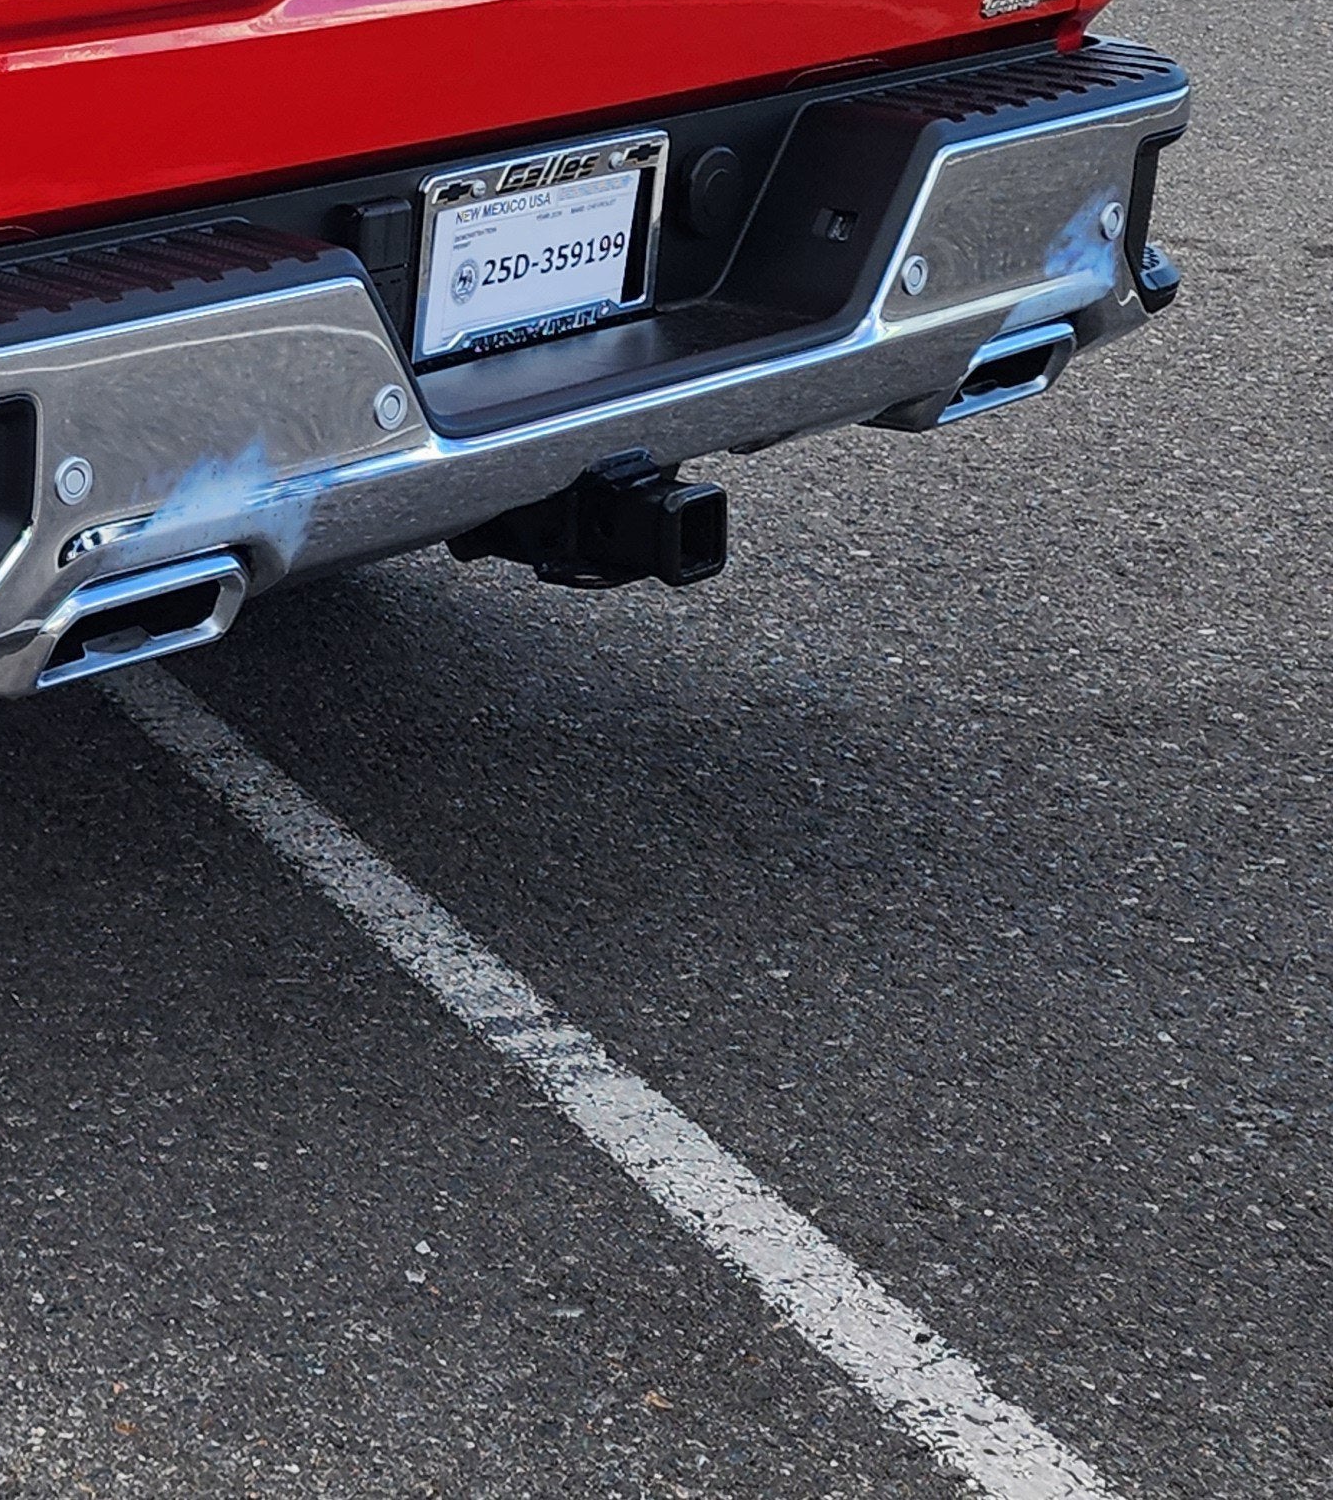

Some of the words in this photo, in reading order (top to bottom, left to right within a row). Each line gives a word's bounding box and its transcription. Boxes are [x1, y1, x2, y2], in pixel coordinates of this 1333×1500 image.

[495, 151, 602, 196] Galles
[455, 205, 484, 226] NEW
[482, 196, 526, 217] MEXICO
[528, 191, 552, 210] USA
[481, 231, 626, 287] 25D-359199
